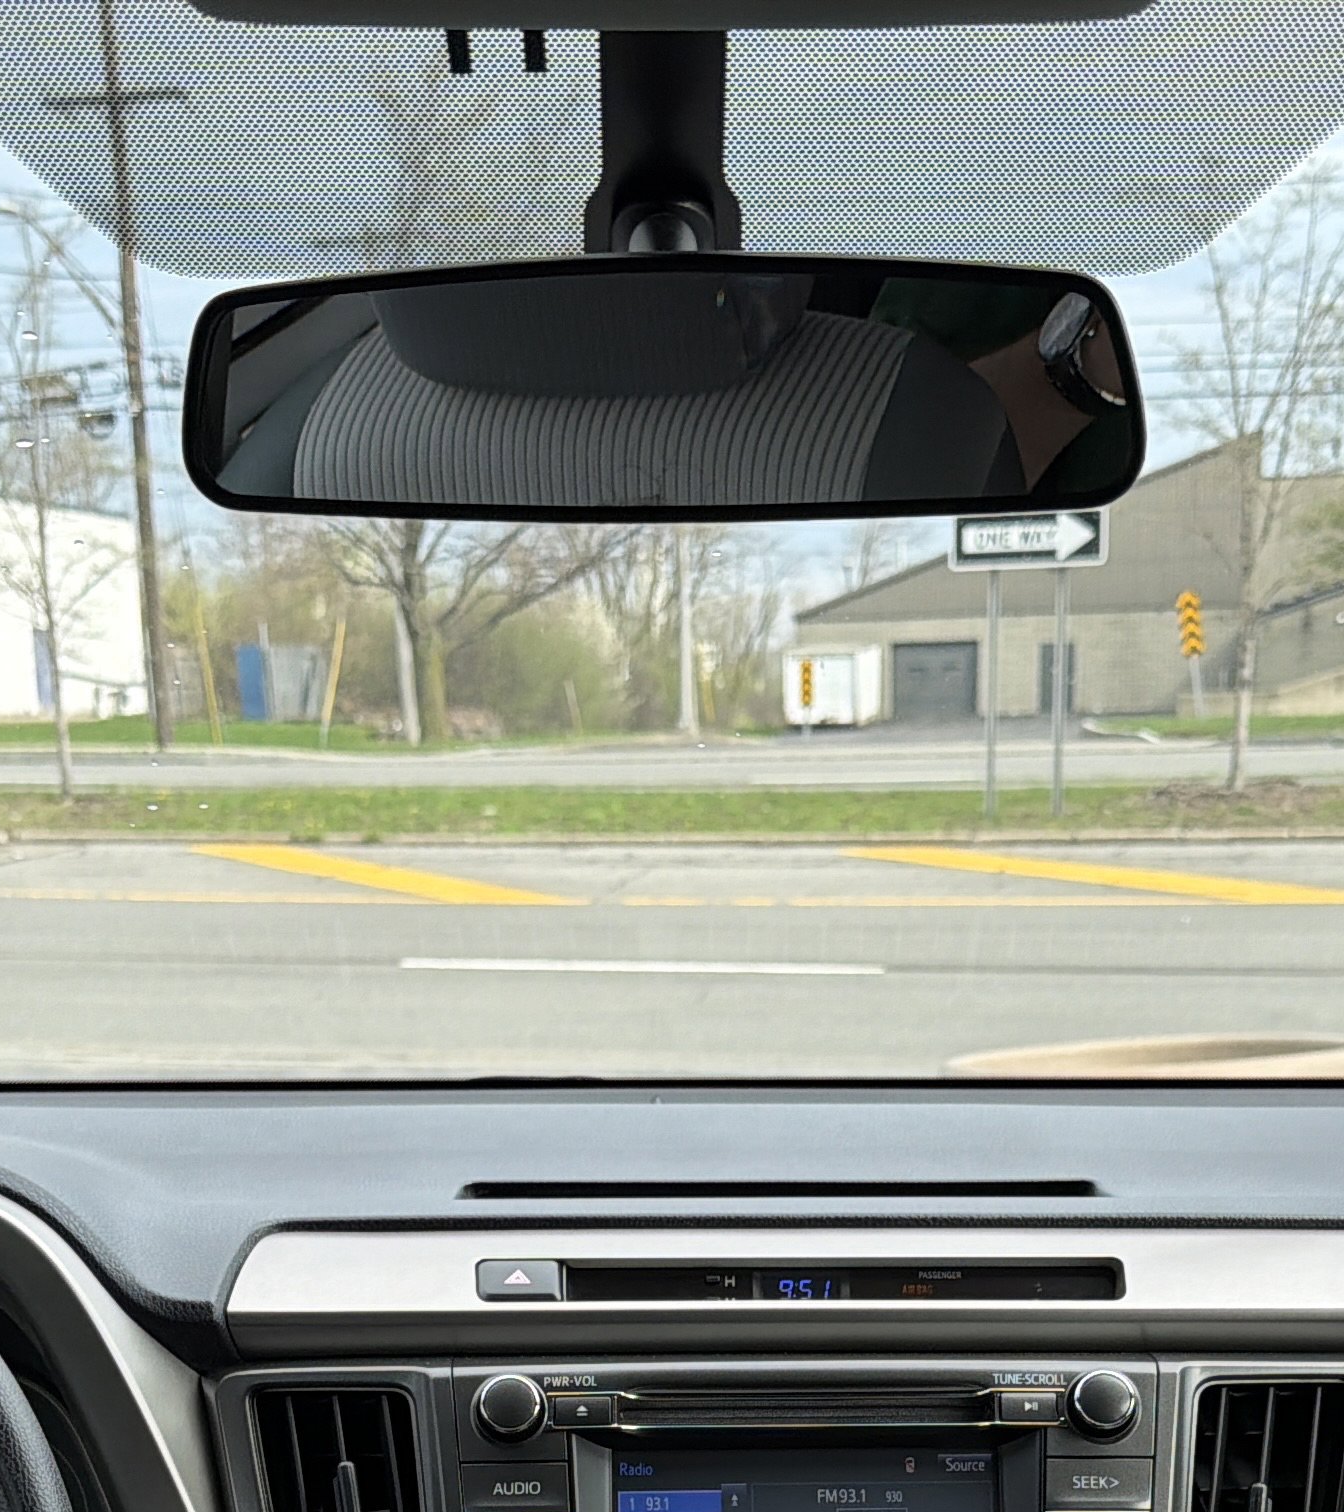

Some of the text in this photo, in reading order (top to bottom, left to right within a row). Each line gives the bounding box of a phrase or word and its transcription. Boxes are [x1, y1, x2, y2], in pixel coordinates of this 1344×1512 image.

[918, 1270, 962, 1280] PASSENGER
[778, 1279, 832, 1300] 9:51
[619, 1462, 654, 1476] Radio
[945, 1457, 986, 1472] Source
[492, 1480, 542, 1496] AUDIO
[629, 1496, 670, 1512] 1 93.1
